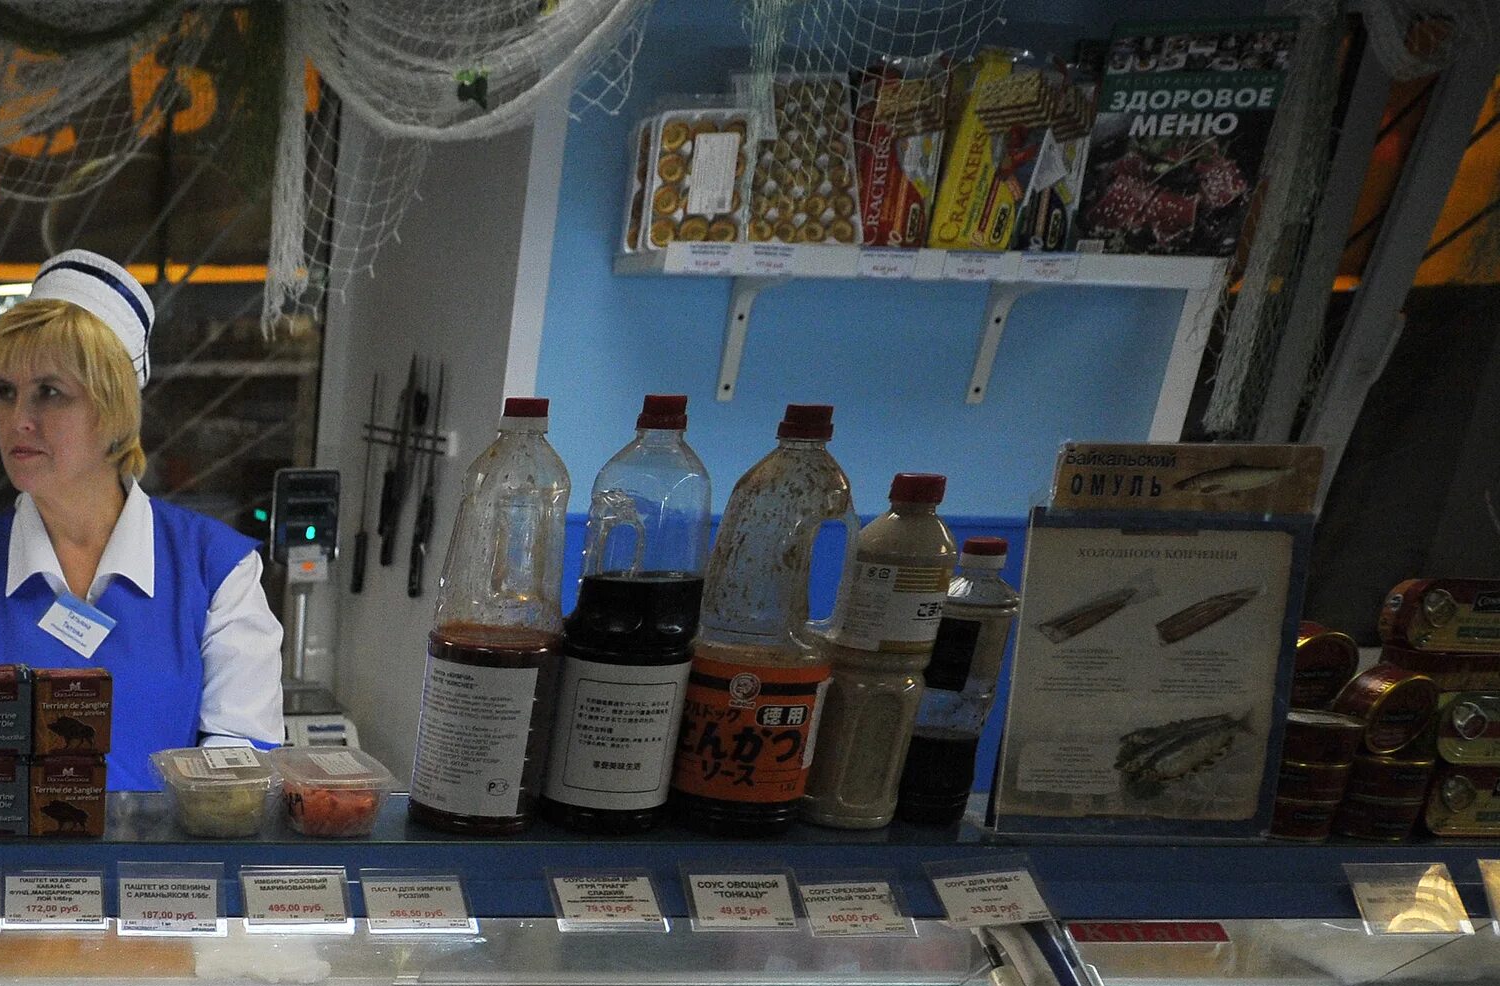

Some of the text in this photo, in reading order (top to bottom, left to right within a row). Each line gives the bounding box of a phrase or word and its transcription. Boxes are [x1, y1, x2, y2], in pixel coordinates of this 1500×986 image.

[1110, 88, 1286, 112] ЗДОРОВОЕ
[1128, 112, 1241, 138] МЕНЮ
[938, 131, 990, 243] CRACKERS
[1066, 451, 1177, 467] Байкальский
[1071, 473, 1161, 497] ОМУЛЬ
[81, 702, 109, 710] Sanglier
[726, 881, 779, 889] ОВОЩНОЙ
[60, 905, 81, 913] руб.
[142, 911, 197, 920] 187,00 руб.
